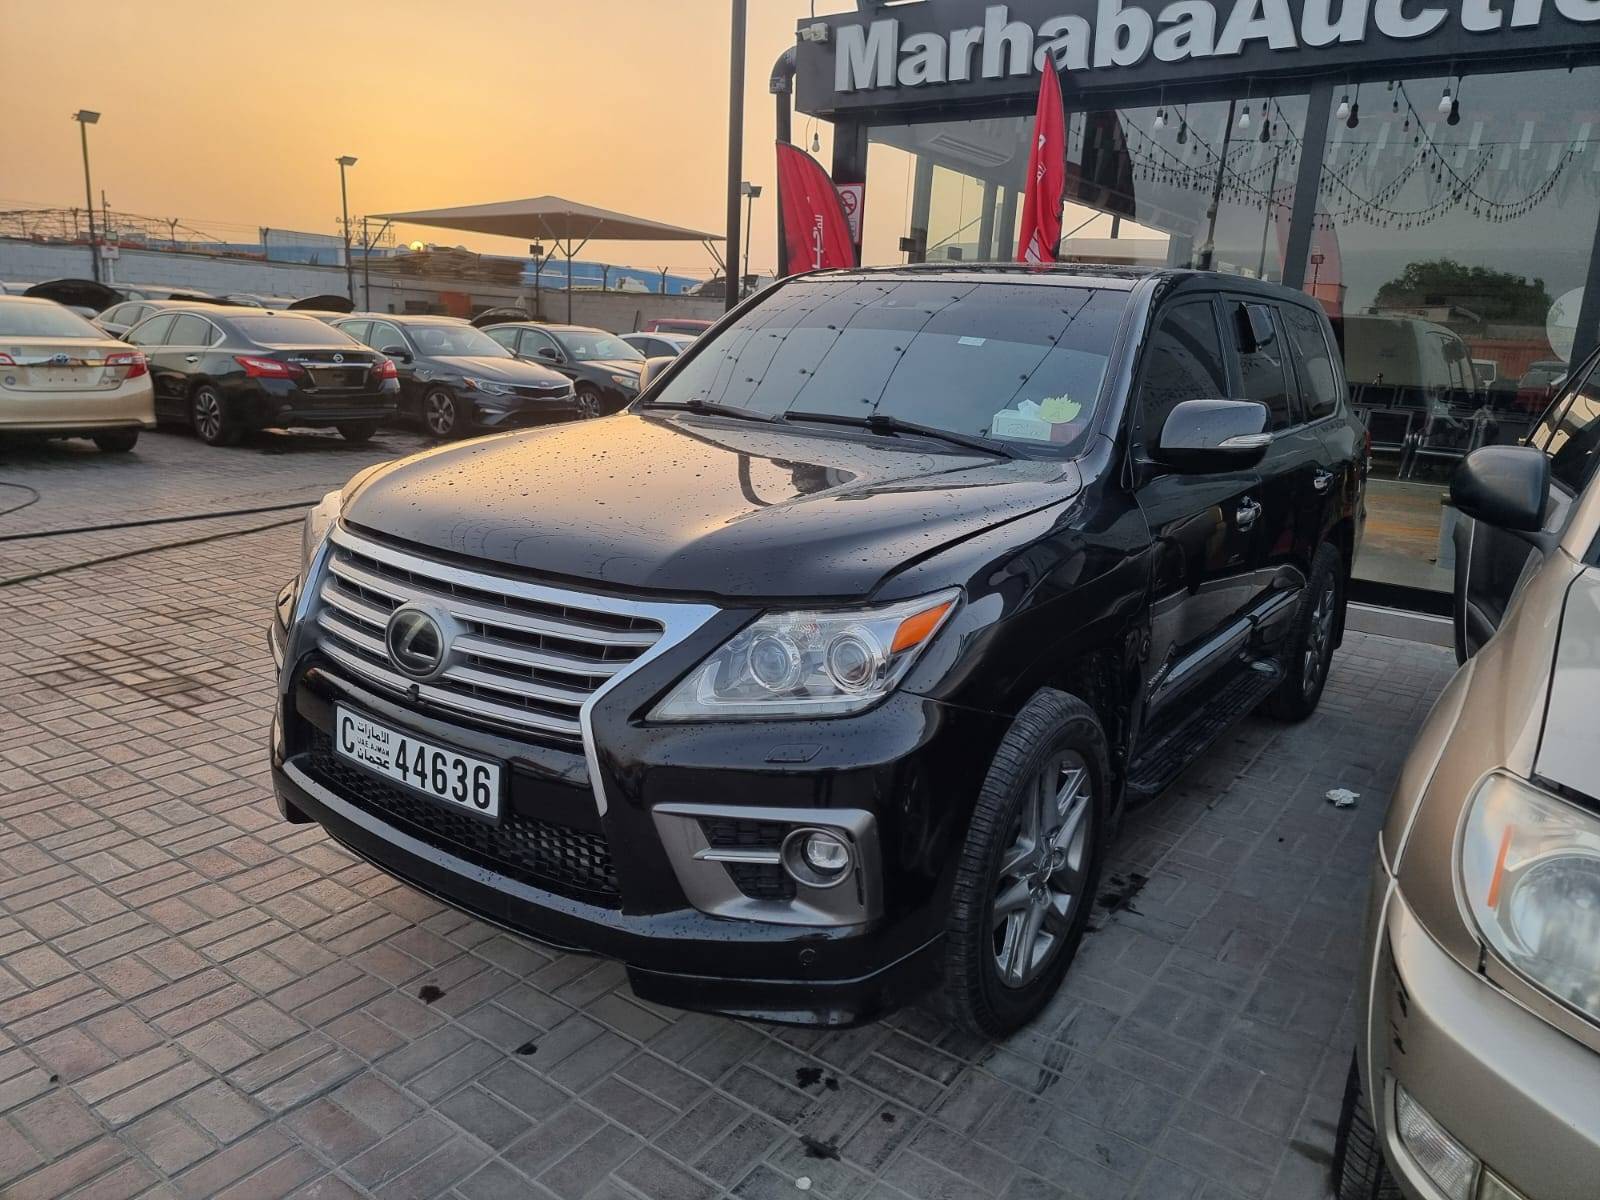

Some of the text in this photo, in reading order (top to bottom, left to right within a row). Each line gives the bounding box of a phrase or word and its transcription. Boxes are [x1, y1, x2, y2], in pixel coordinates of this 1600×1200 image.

[834, 0, 1600, 91] MarhabaAuc
[342, 716, 355, 754] C
[357, 748, 390, 770] عجمان
[395, 739, 491, 810] 44636
